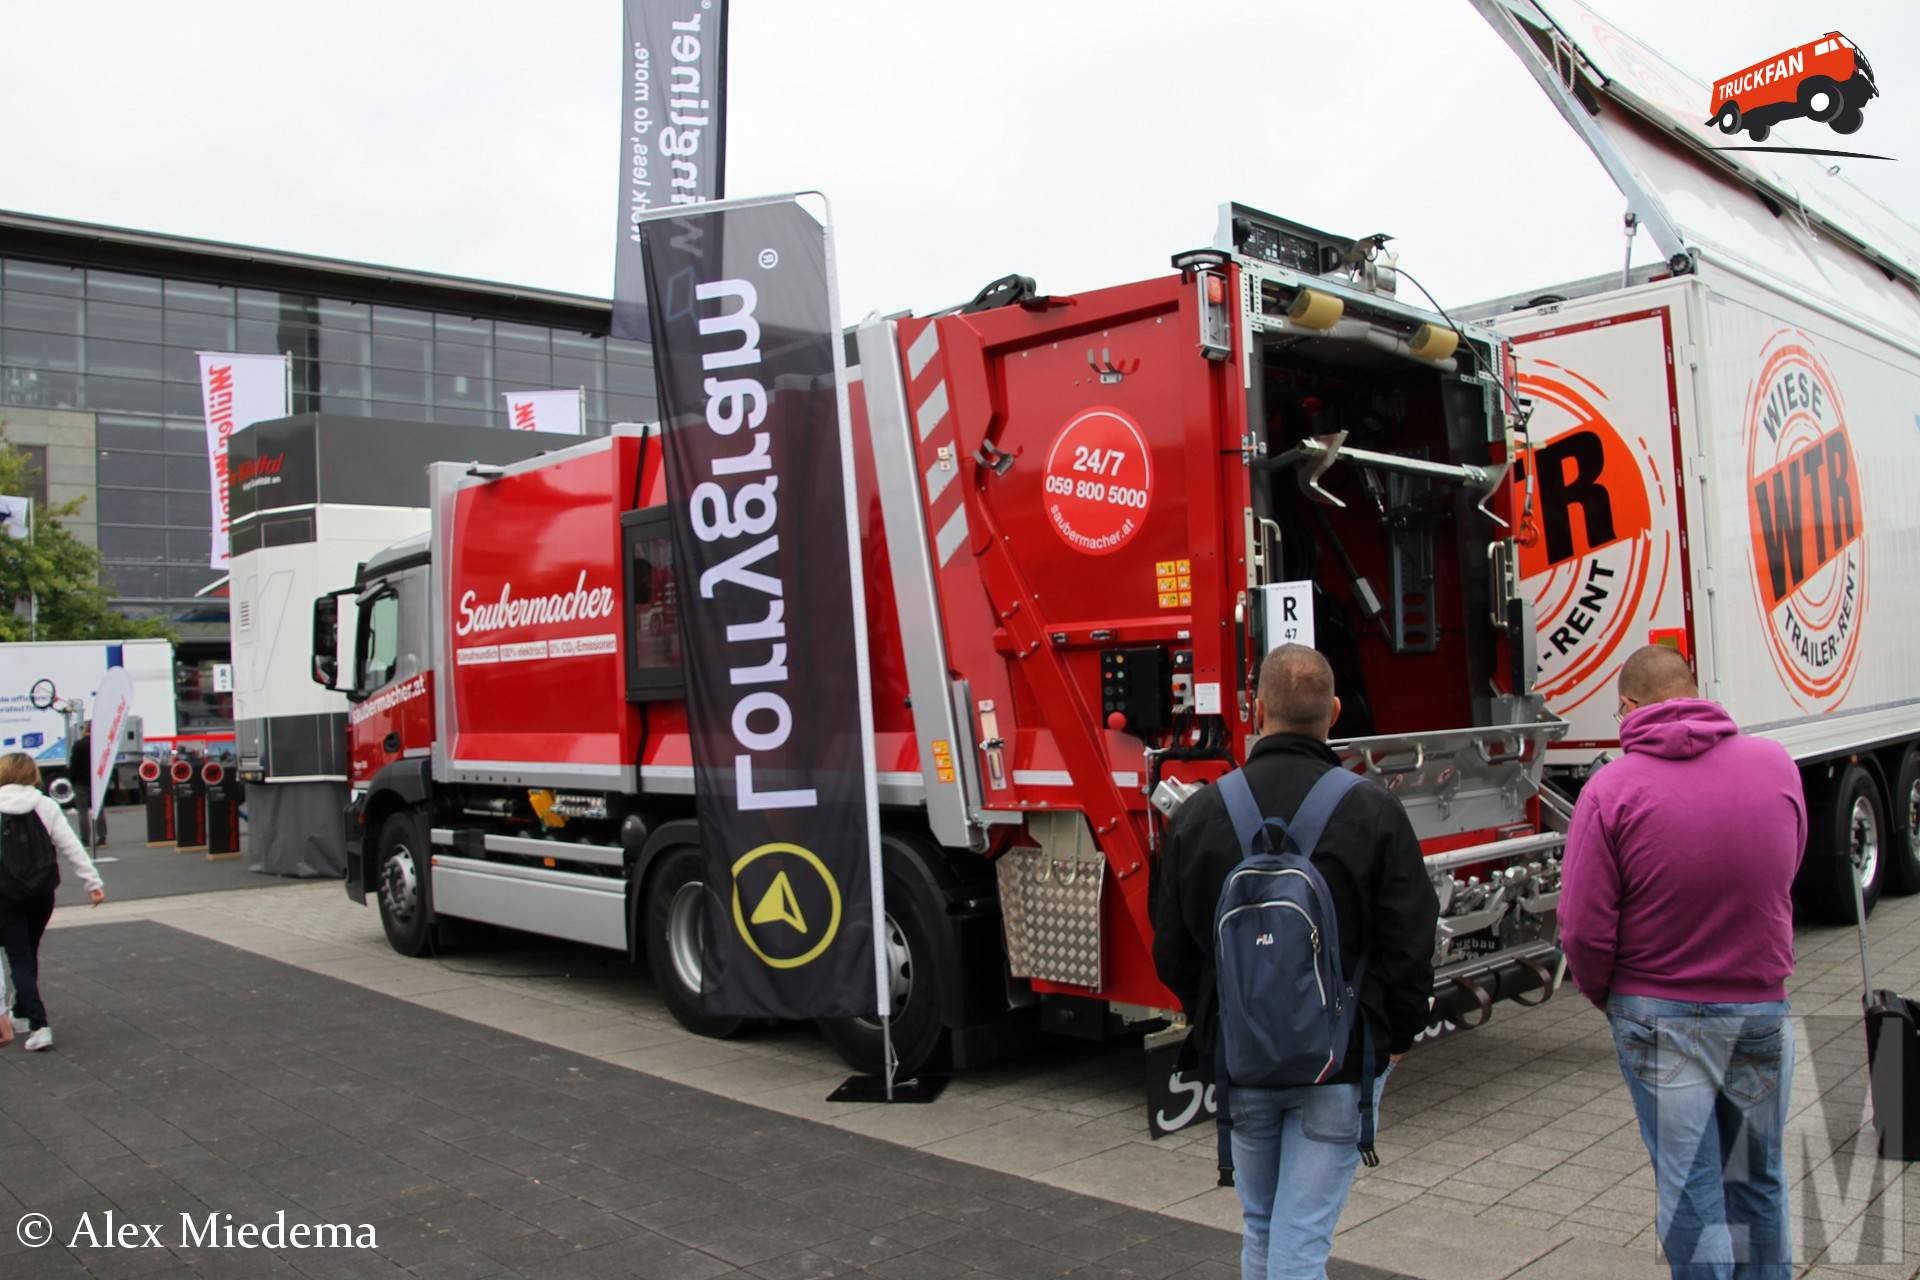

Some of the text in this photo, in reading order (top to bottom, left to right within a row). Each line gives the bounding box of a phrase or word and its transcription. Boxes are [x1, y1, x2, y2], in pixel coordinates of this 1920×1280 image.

[1762, 366, 1822, 444] WIESE
[1073, 446, 1125, 477] 24/7
[1045, 474, 1148, 509] 059 800 5000
[1050, 504, 1135, 550] saubermacher.at
[1754, 430, 1855, 603] WTR
[456, 569, 614, 636] Saubermacher
[1283, 596, 1298, 621] R
[1536, 559, 1615, 672] -RENT
[1783, 552, 1856, 668] TRAILER-RENT
[1284, 628, 1297, 640] 47
[1256, 932, 1274, 946] FILA
